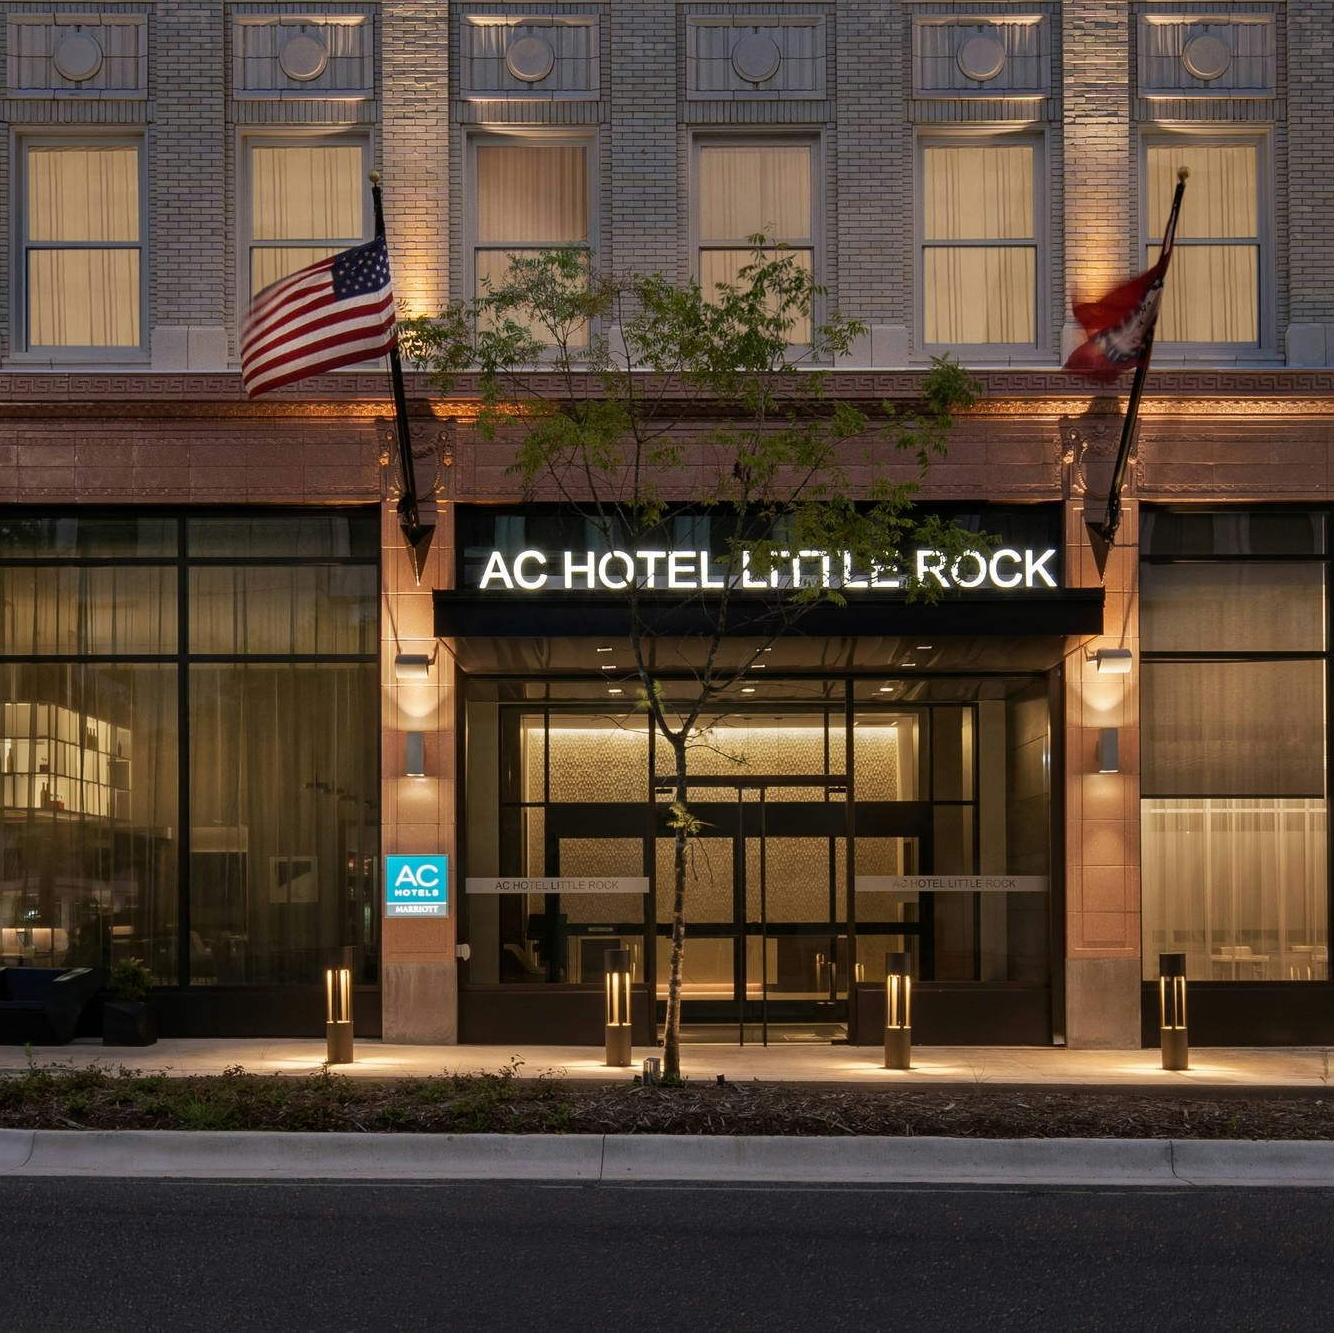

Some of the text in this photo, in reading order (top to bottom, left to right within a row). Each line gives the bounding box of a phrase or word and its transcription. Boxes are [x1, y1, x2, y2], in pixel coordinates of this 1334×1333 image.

[479, 550, 548, 589] AC
[564, 550, 725, 589] HOTEL
[917, 549, 1057, 588] ROCK
[394, 864, 440, 887] AC
[495, 880, 619, 890] AC HOTEL LITTLE ROCK
[910, 879, 947, 888] HOTEL
[948, 878, 981, 888] LITTLE
[985, 878, 1016, 888] ROCK
[394, 889, 439, 897] HOTELS
[395, 905, 439, 913] MARRIOTT
